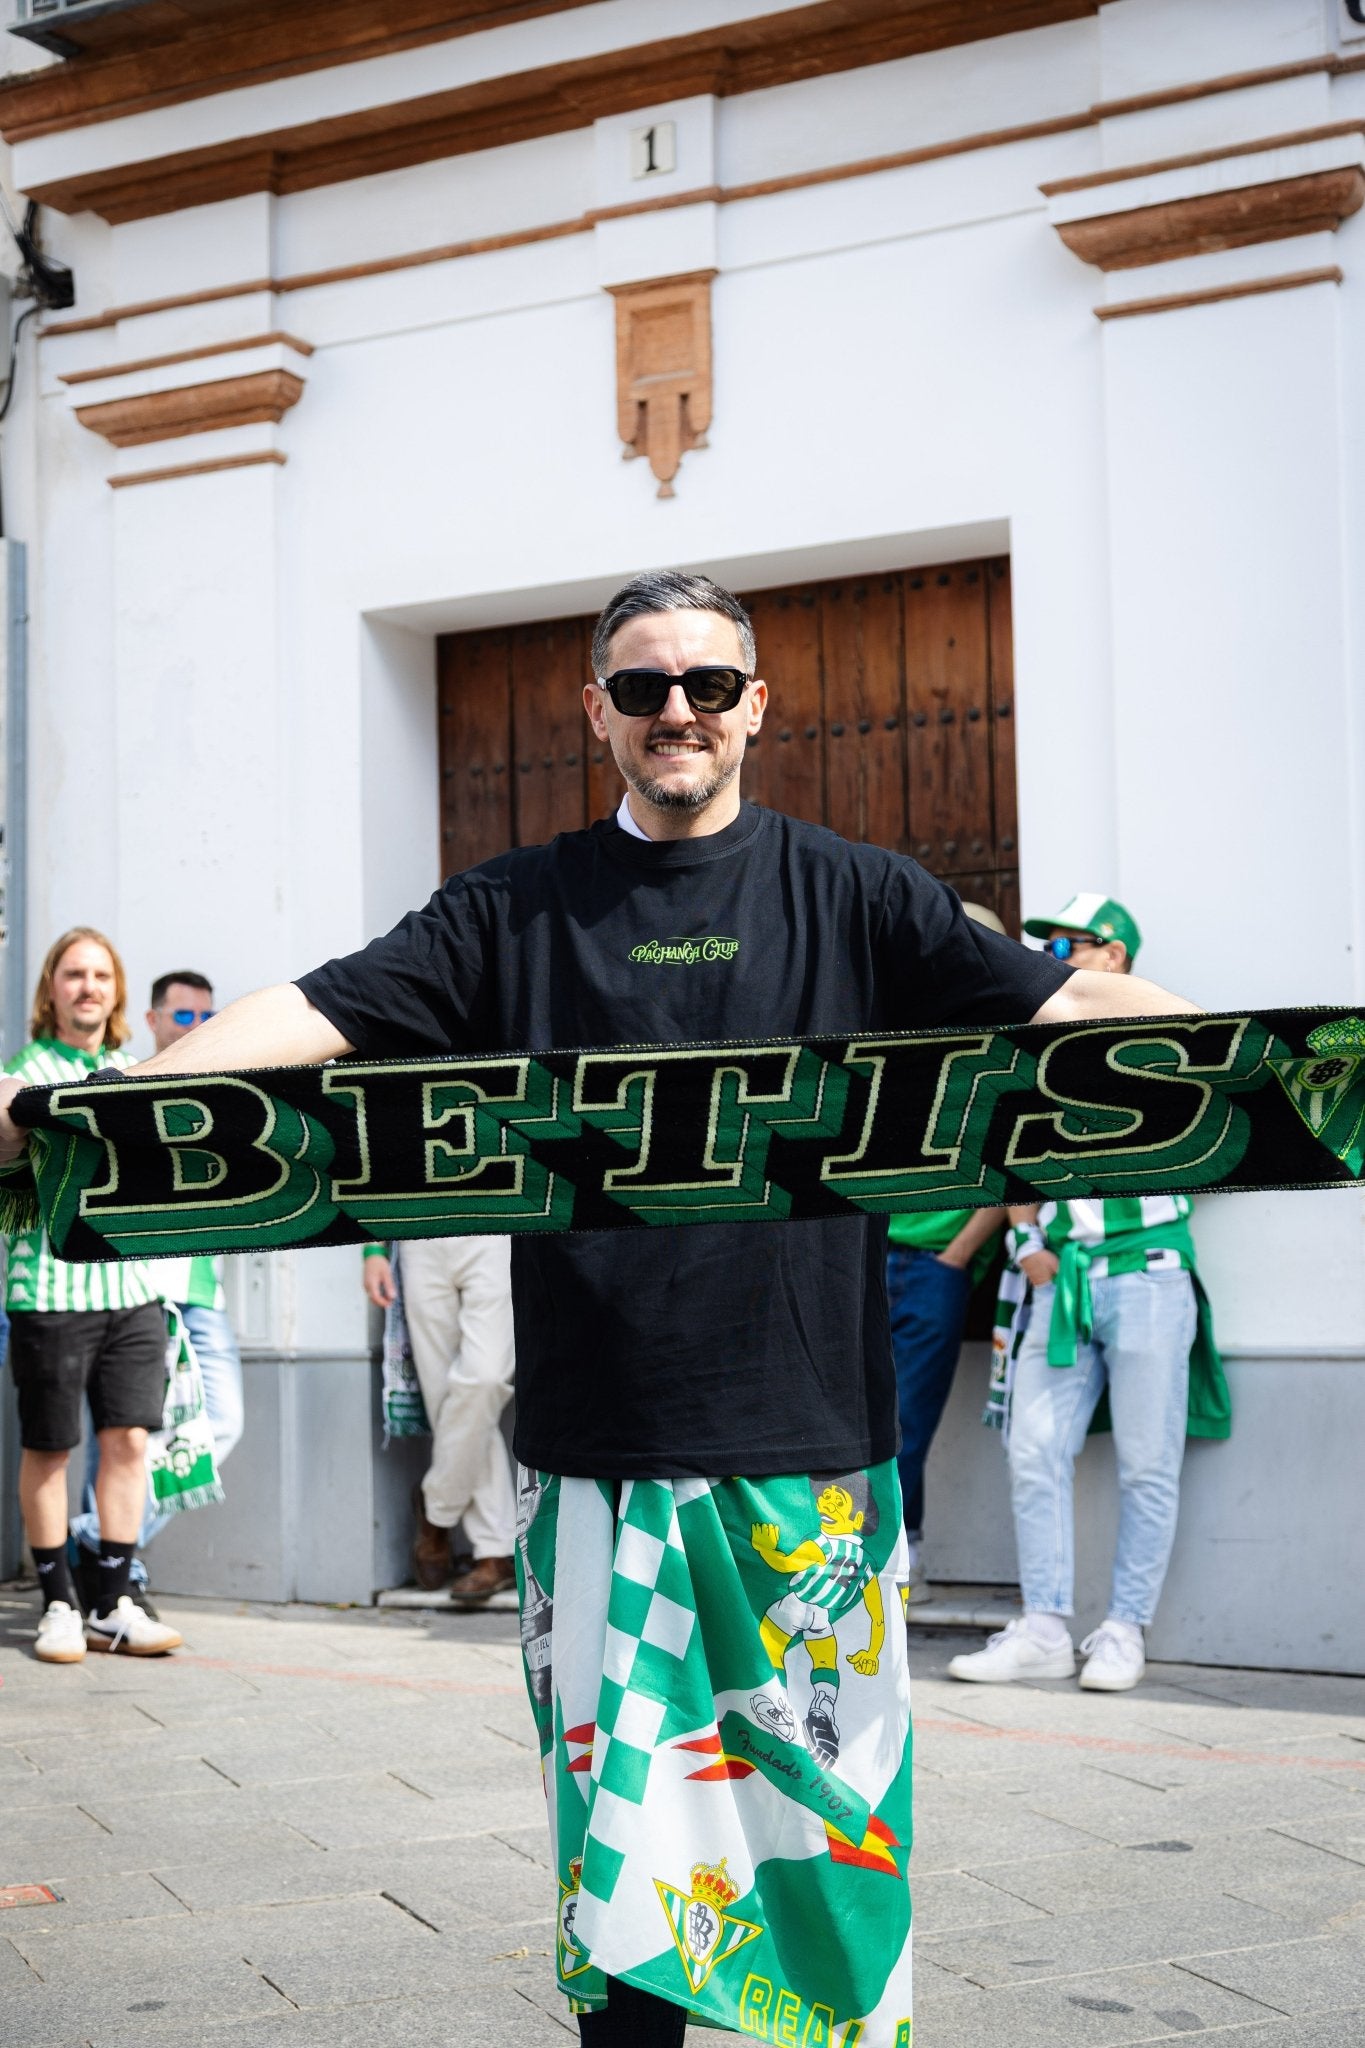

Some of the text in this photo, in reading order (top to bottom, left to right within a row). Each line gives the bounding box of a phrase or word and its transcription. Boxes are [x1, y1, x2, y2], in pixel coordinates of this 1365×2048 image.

[643, 126, 659, 172] 1
[49, 1017, 1254, 1218] BETIS
[809, 1775, 854, 1820] 1907
